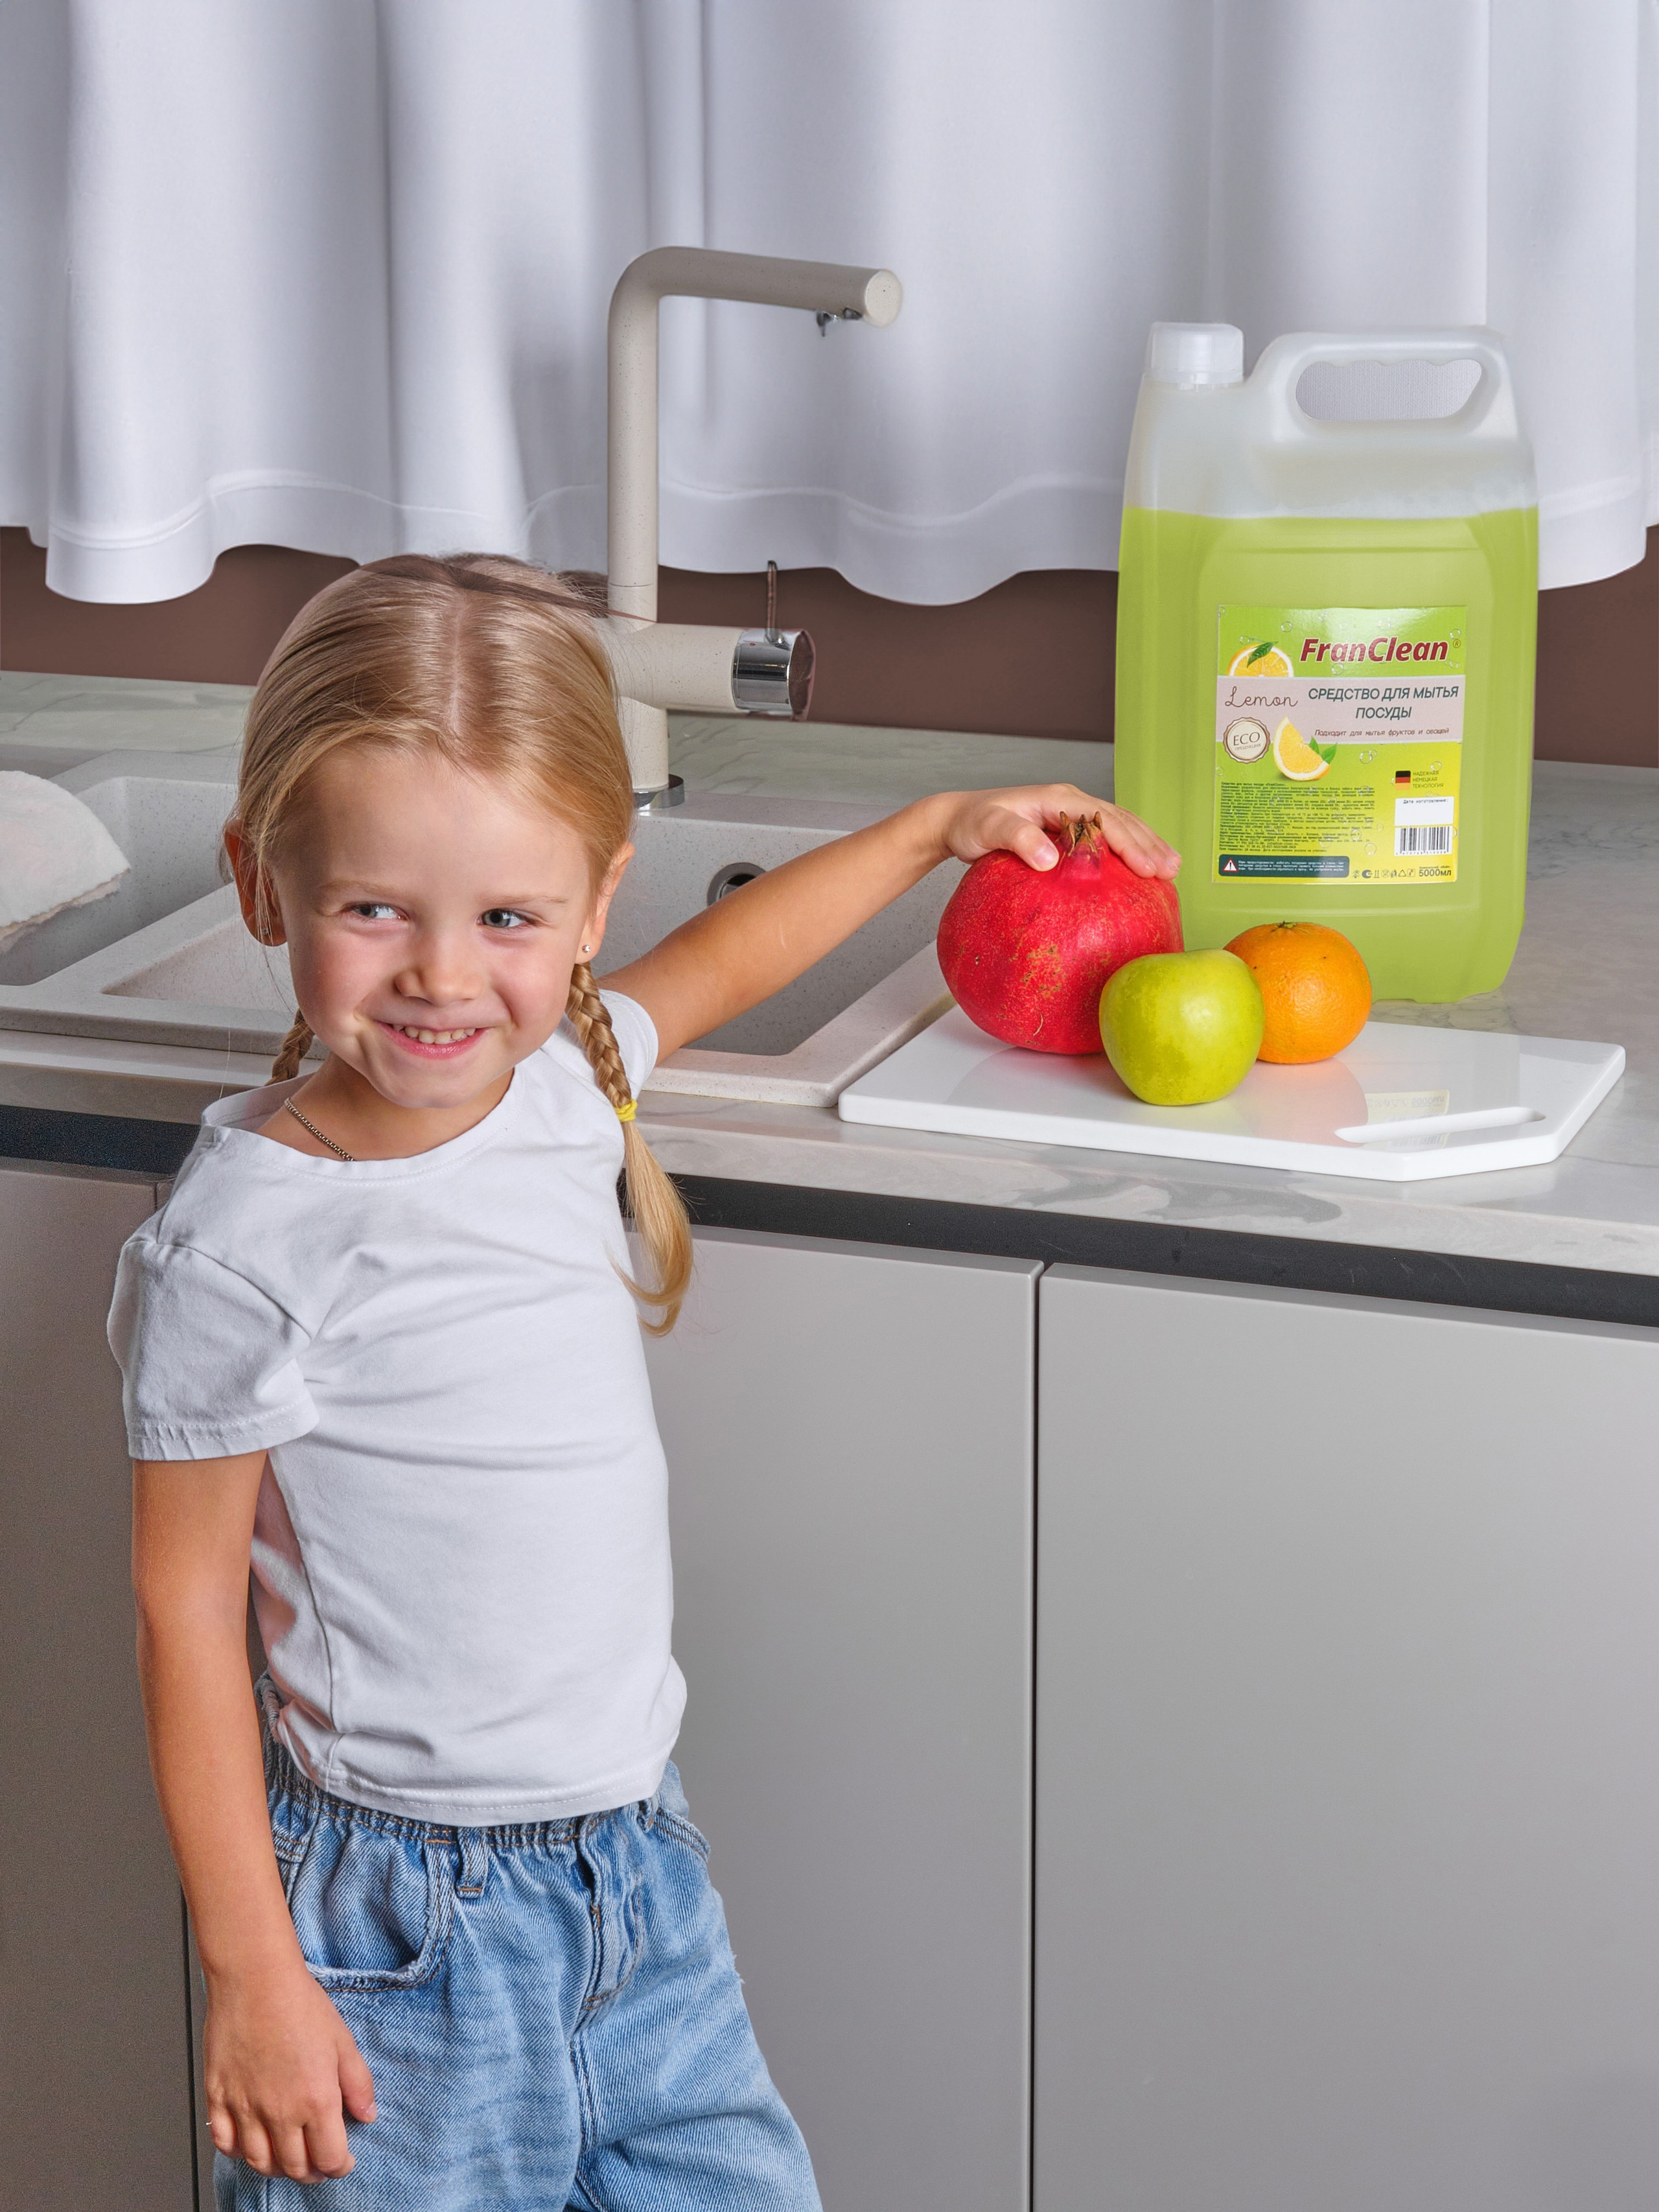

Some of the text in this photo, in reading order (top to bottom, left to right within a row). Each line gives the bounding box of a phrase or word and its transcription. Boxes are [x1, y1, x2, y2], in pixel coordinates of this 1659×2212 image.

[1300, 636, 1448, 662] FranClean
[1225, 686, 1298, 707] Lemon
[1308, 686, 1459, 702] СРЕДСТВО ДЛЯ МЫТЬЯ
[1356, 706, 1412, 721] ПОСУДЫ
[1233, 732, 1260, 746] ECO
[1388, 728, 1415, 737] фруктов
[1419, 868, 1452, 877] 5000мл
